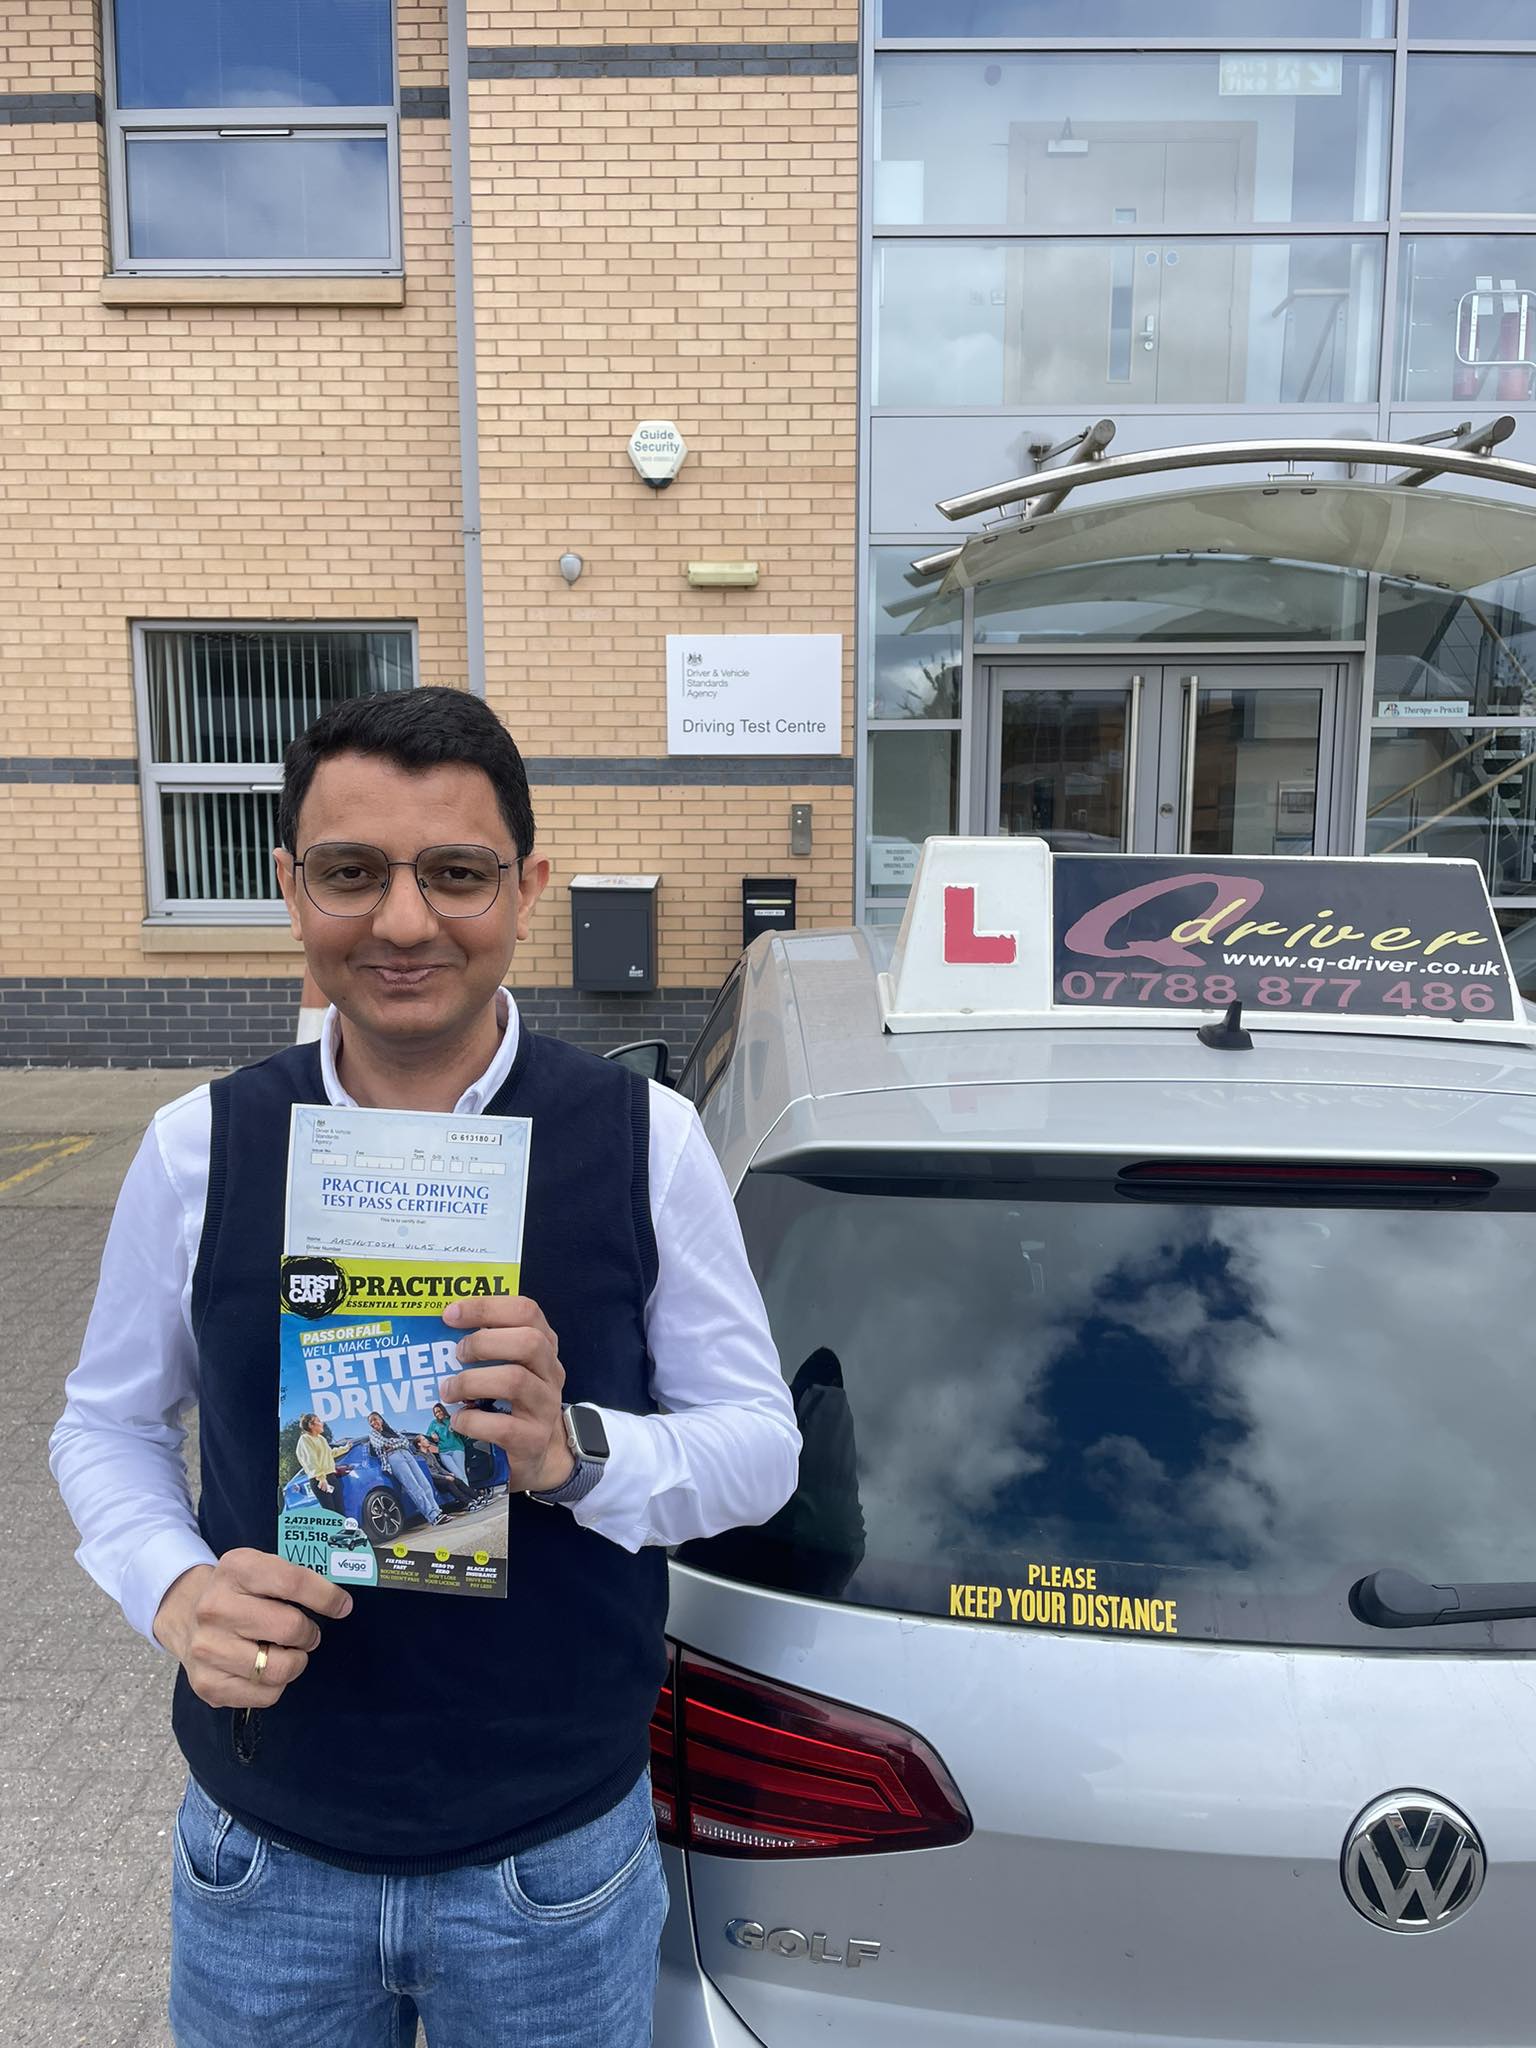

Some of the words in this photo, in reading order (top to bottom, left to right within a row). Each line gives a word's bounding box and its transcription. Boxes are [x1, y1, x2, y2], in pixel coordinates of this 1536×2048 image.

[640, 430, 674, 440] Guide
[634, 441, 680, 454] Security
[687, 668, 711, 678] Driver
[713, 668, 719, 678] &
[721, 668, 750, 678] Vehicle
[687, 679, 729, 688] Standards
[687, 689, 718, 699] Agency
[682, 718, 735, 737] Driving
[740, 718, 771, 733] Test
[775, 718, 827, 733] Centre
[943, 885, 1017, 965] L
[1222, 949, 1502, 977] www.q-driver.co.uk
[1060, 970, 1238, 1006] 07788
[1257, 977, 1362, 1009] 877
[1382, 979, 1496, 1013] 486
[451, 1133, 458, 1141] G
[460, 1134, 489, 1142] 613180
[322, 1177, 410, 1196] PRACTICAL
[416, 1183, 489, 1200] DRIVING
[322, 1194, 355, 1208] TEST
[359, 1196, 392, 1210] PASS
[397, 1199, 489, 1216] CERTIFICATE
[289, 1275, 339, 1290] FIRST
[348, 1276, 510, 1297] PRACTICAL
[288, 1288, 326, 1304] CAR
[346, 1300, 398, 1309] ESSENTIAL
[401, 1301, 423, 1309] TIPS
[424, 1301, 443, 1309] FOR
[303, 1330, 336, 1344] PASS
[336, 1328, 354, 1339] OR
[302, 1344, 335, 1358] WE'LL
[338, 1339, 371, 1353] MAKE
[374, 1336, 399, 1349] YOU
[401, 1334, 410, 1345] A
[305, 1340, 464, 1390] BETTER
[284, 1517, 309, 1525] 2,473
[310, 1517, 343, 1527] PRIZES
[285, 1530, 328, 1542] £51,518
[285, 1543, 328, 1563] WIN
[1027, 1564, 1097, 1591] PLEASE
[949, 1584, 1002, 1619] KEEP
[1006, 1587, 1067, 1627] YOUR
[1070, 1592, 1178, 1634] DISTANCE
[724, 1917, 881, 1968] GOLF
